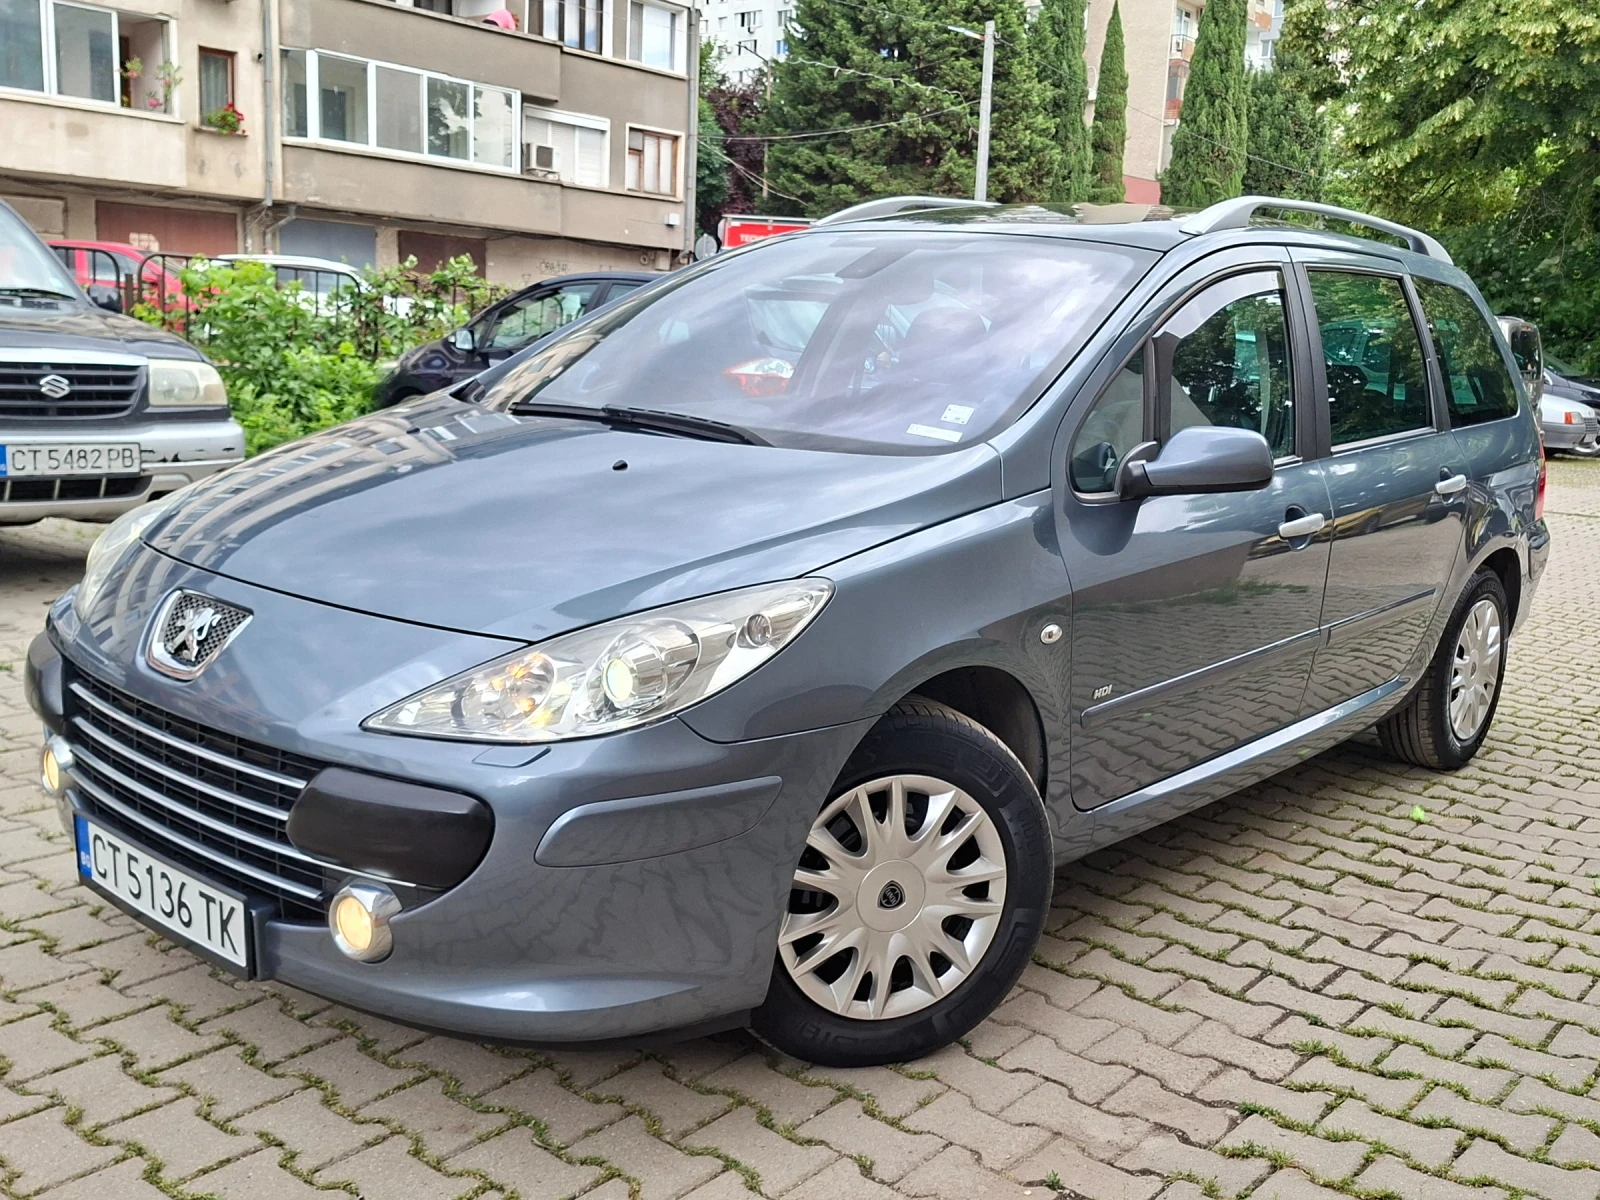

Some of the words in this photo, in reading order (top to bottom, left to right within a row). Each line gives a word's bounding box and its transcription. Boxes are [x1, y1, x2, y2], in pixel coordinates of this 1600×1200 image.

[12, 450, 41, 471] CT
[48, 449, 102, 470] 5482
[107, 448, 134, 468] PB
[80, 851, 91, 868] BG
[93, 833, 121, 888] CT
[126, 852, 193, 929] 5136
[198, 889, 239, 956] TK
